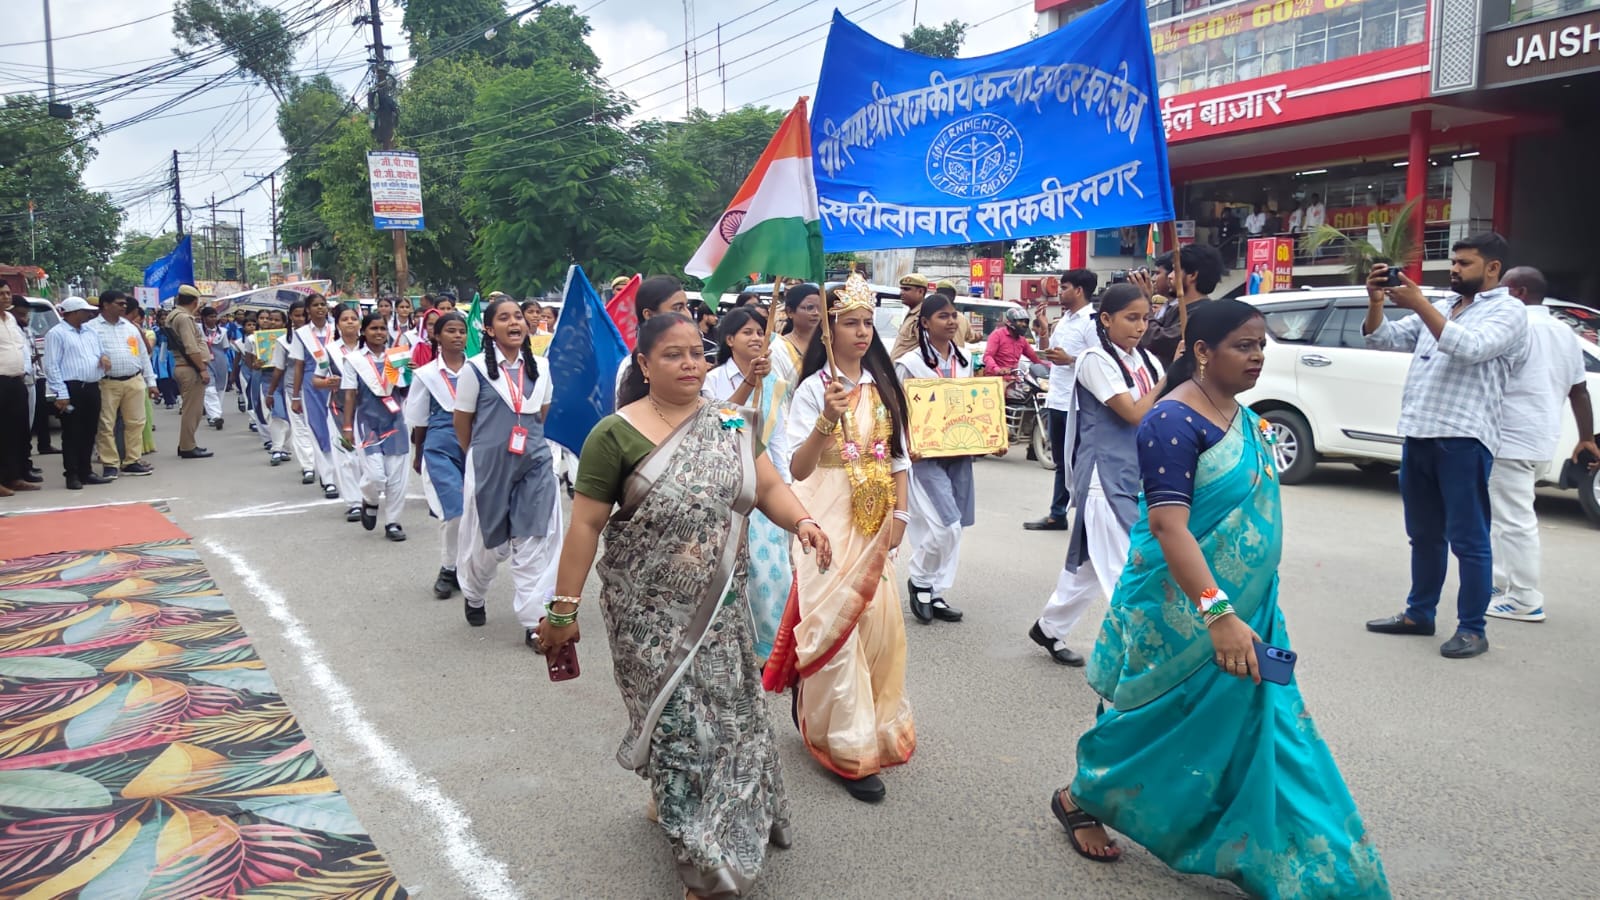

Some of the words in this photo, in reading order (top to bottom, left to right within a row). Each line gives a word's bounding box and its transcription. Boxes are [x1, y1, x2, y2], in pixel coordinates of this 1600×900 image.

[931, 118, 1000, 161] GOVERNMENT
[996, 124, 1014, 140] OF
[971, 159, 1018, 196] PRADESH
[1276, 266, 1291, 275] SALE
[1276, 274, 1291, 283] SALE
[1275, 282, 1290, 290] SALE
